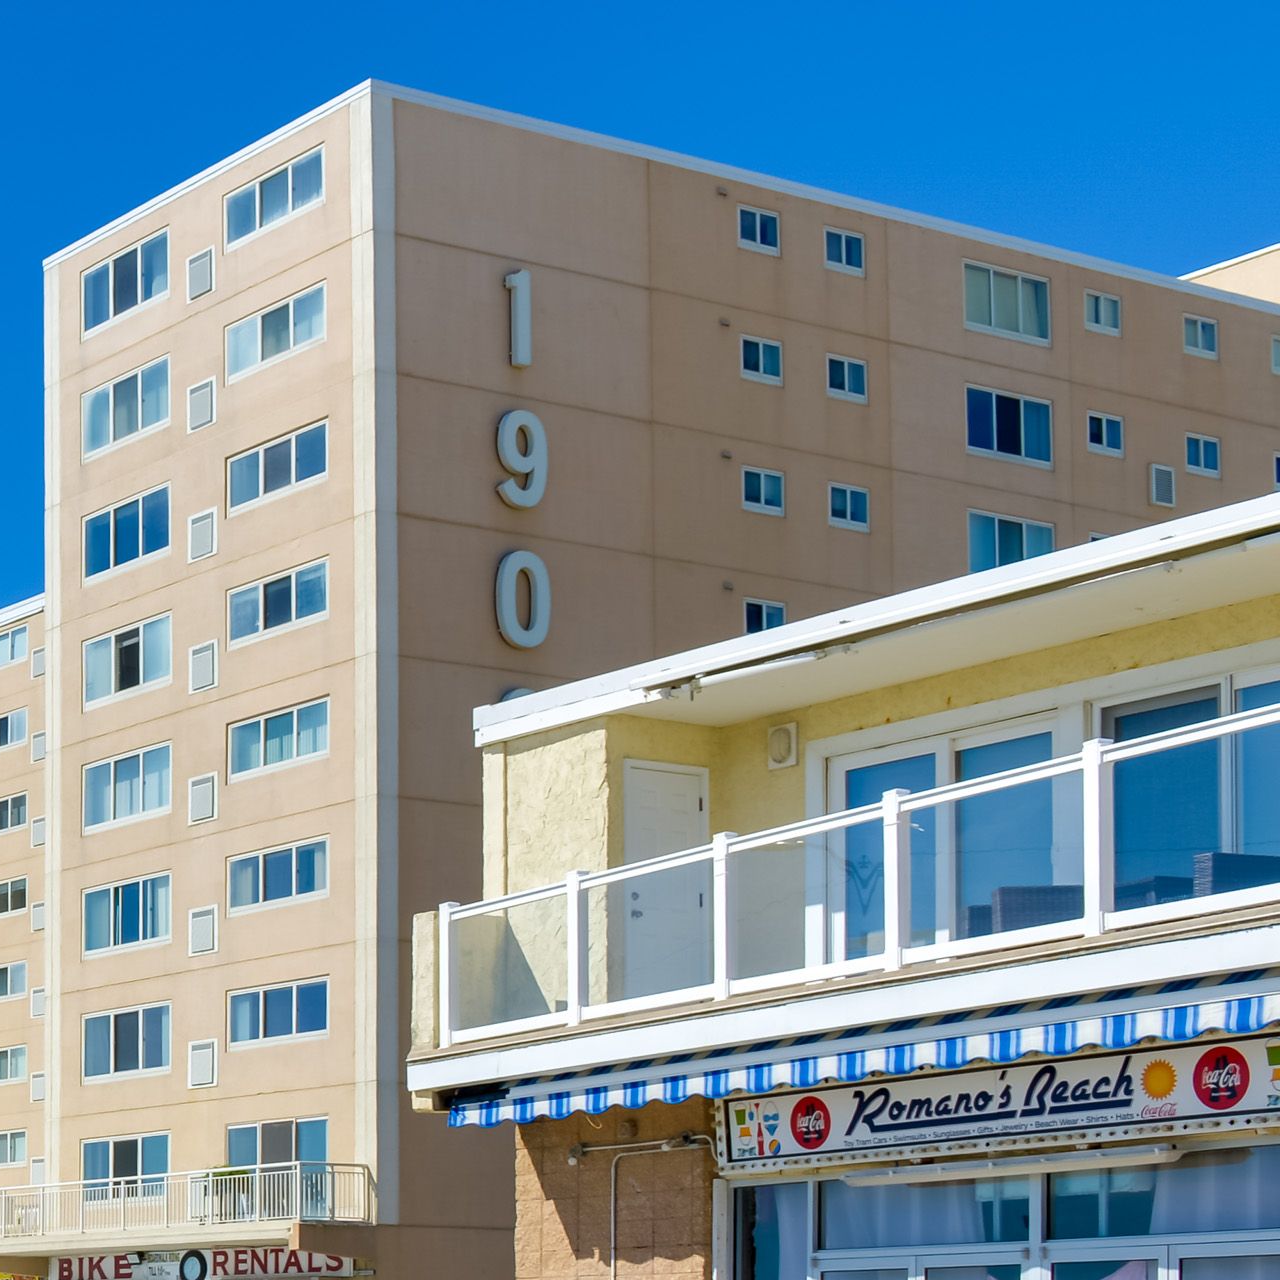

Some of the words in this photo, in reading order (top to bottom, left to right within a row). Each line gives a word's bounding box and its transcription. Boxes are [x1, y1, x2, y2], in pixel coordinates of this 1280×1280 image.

[844, 1070, 1012, 1136] Romano's
[1020, 1055, 1134, 1115] Beach
[933, 1129, 972, 1140] Sunglasses
[977, 1126, 993, 1134] Gifts
[999, 1122, 1028, 1132] Jewelry
[1035, 1119, 1058, 1128] Beach
[1059, 1117, 1080, 1126] Wear
[1086, 1114, 1109, 1123] Shirts
[1116, 1112, 1134, 1121] Hats
[1141, 1103, 1178, 1119] Coca-Cola
[58, 1255, 133, 1280] BIKE
[212, 1248, 344, 1277] RENTALS
